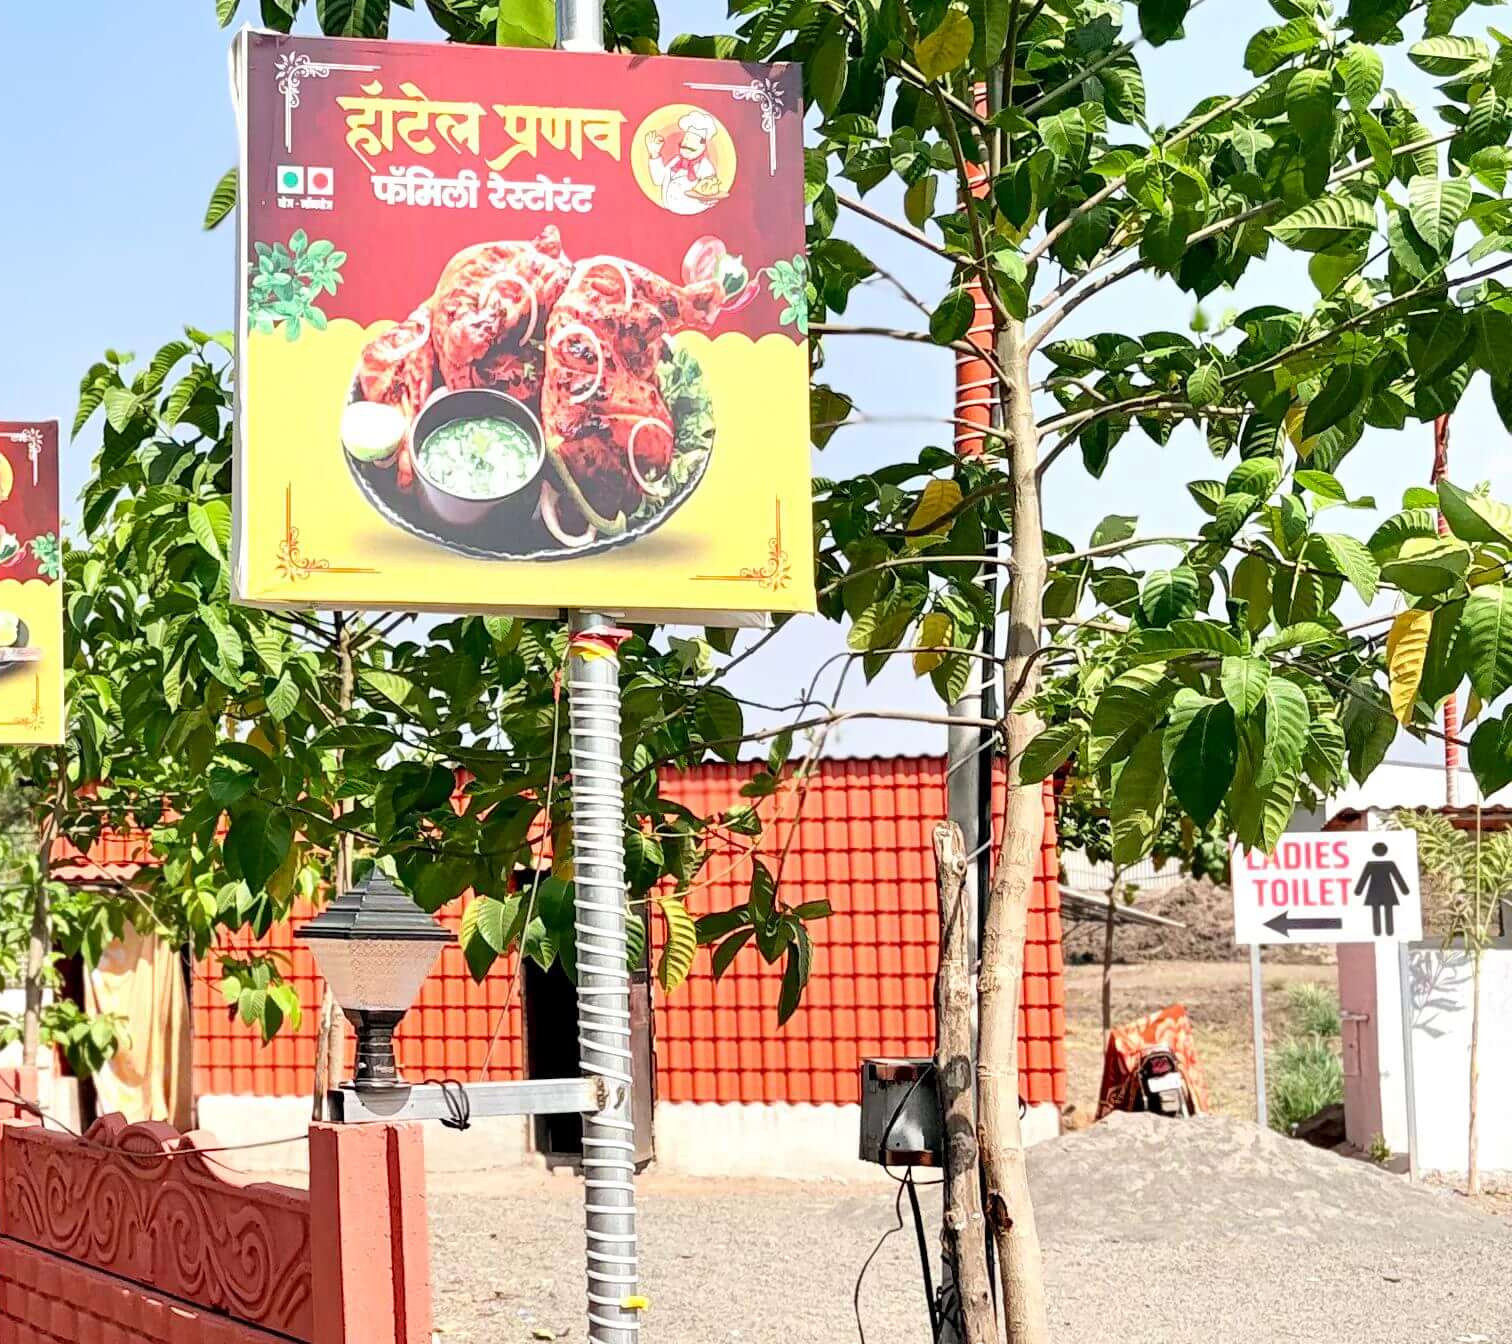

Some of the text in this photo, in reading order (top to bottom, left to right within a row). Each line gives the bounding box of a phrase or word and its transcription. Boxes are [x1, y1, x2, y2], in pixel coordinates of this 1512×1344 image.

[336, 79, 628, 173] हॉटेल प्रणव
[370, 166, 596, 213] फॅमिली रेस्टोरंट
[1252, 878, 1352, 907] TOILET
